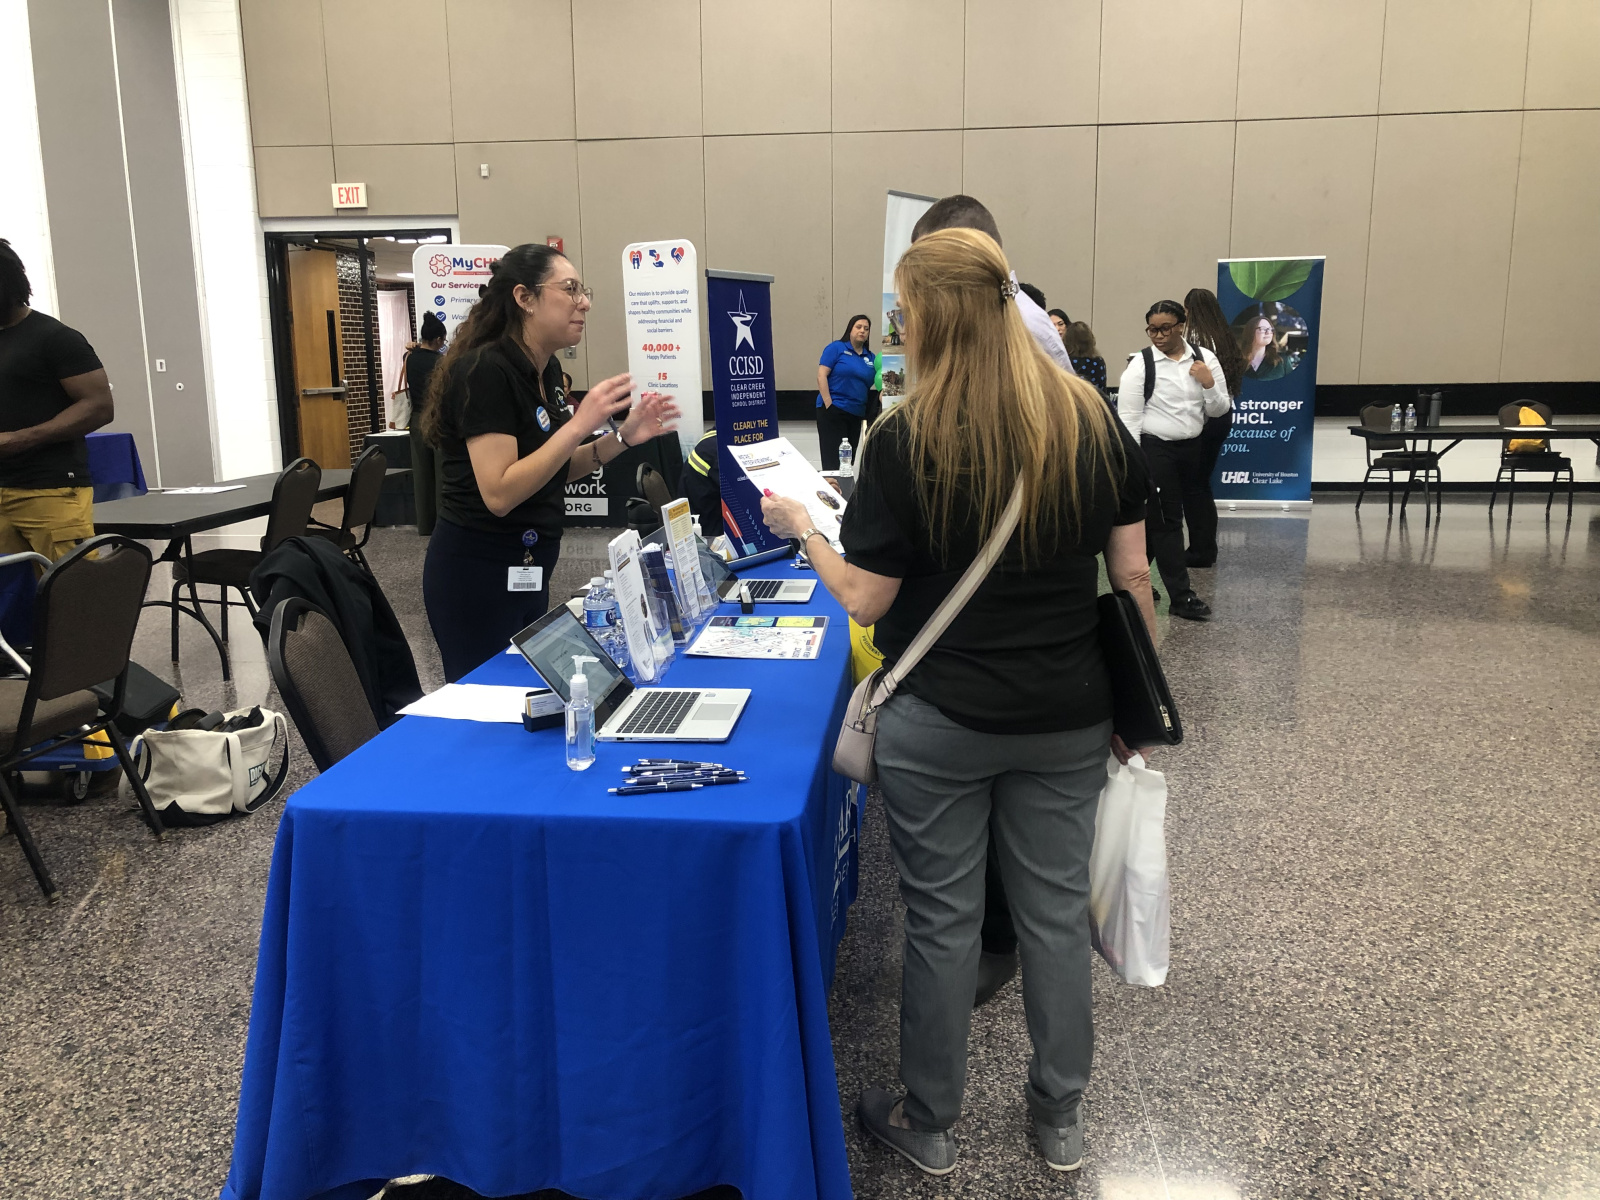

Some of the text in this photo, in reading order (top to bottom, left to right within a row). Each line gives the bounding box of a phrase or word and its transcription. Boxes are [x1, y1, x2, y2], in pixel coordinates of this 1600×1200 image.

[338, 186, 360, 205] EXIT
[676, 288, 689, 296] quality
[642, 343, 674, 353] 40,000
[729, 355, 764, 376] CCISD
[658, 372, 668, 381] 15
[730, 382, 766, 392] CLEAR CREEK
[730, 391, 766, 401] INDEPENDENT
[731, 399, 767, 408] SCHOOL DISTRICT
[1240, 399, 1304, 413] stronger
[733, 418, 769, 431] CLEARLY THE
[733, 432, 764, 444] PLACE FOR
[1280, 426, 1297, 442] of
[1221, 443, 1250, 456] you.
[1221, 471, 1251, 484] UHCL
[1252, 471, 1275, 479] University
[564, 479, 607, 495] work
[564, 502, 593, 513] ORG
